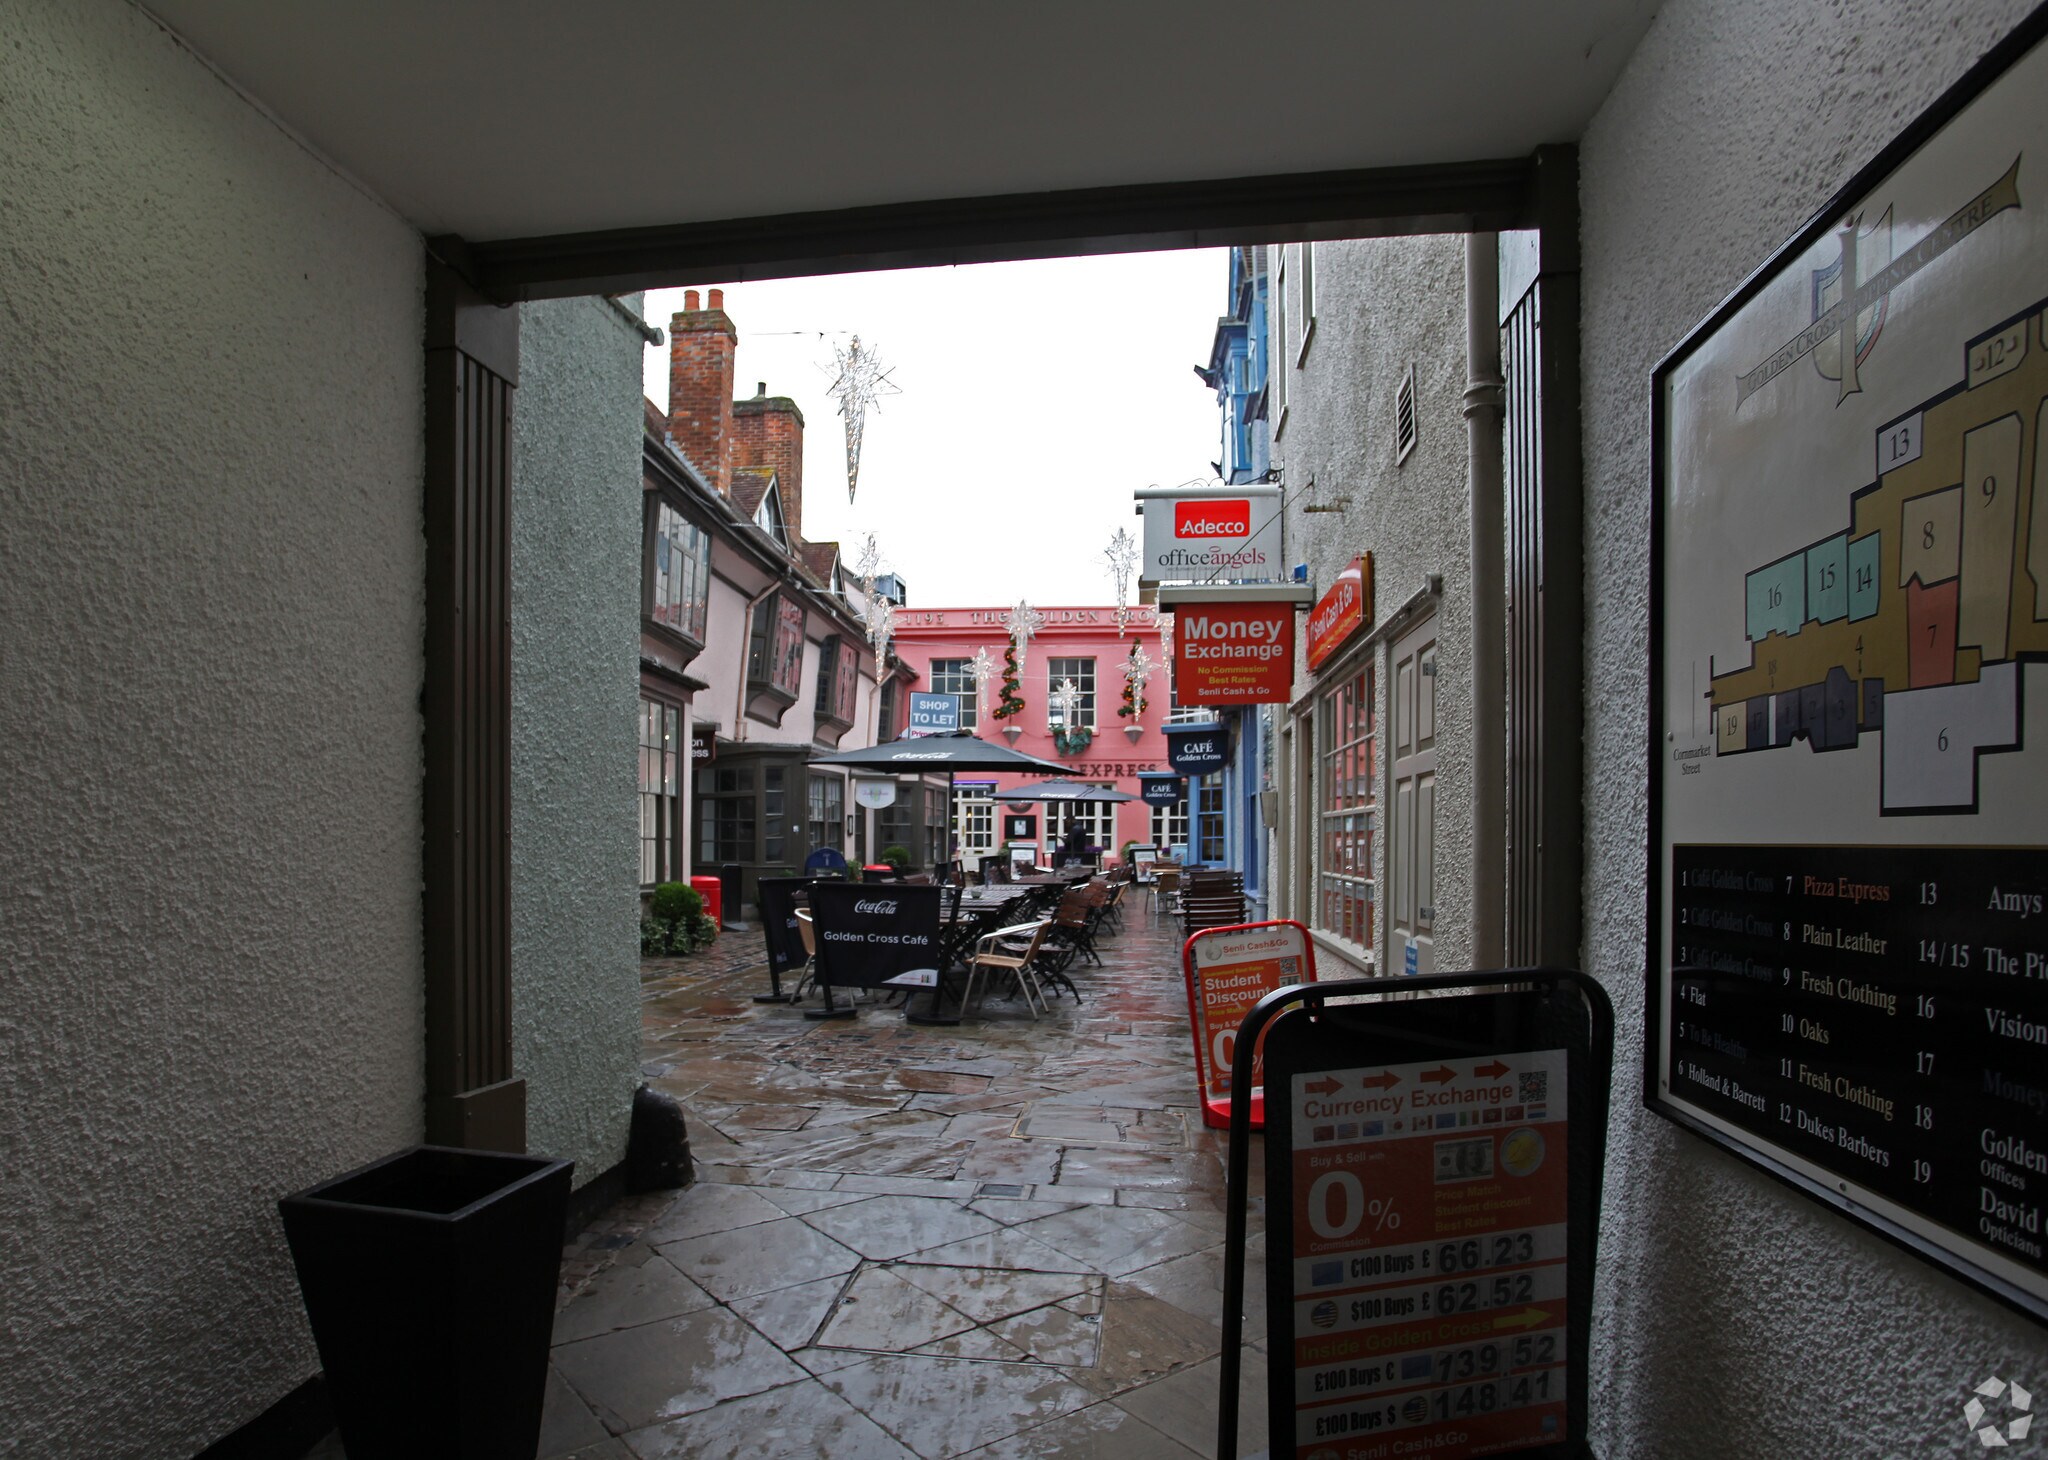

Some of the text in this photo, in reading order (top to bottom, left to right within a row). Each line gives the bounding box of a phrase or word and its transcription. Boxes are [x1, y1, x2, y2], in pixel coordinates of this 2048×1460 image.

[1986, 338, 2005, 370] 12
[1890, 428, 1910, 463] 13
[1982, 475, 1996, 508] 9
[1180, 519, 1245, 535] Adecco
[1922, 520, 1935, 550] 8
[1819, 563, 1835, 592] 15
[1855, 565, 1873, 592] 14
[1326, 598, 1339, 629] Cash
[1344, 583, 1353, 608] Go
[1768, 583, 1782, 609] 16
[1184, 617, 1283, 644] Money
[1927, 624, 1937, 649] 7
[1184, 642, 1283, 661] Exchange
[1855, 635, 1864, 656] 4
[1198, 665, 1268, 674] No Commission
[1208, 675, 1257, 684] Best Rates
[1198, 687, 1270, 696] Senli Cash & Go
[913, 713, 955, 725] TO LET
[919, 700, 949, 711] SHOP
[1726, 715, 1738, 736] 19
[1184, 740, 1213, 754] CAFÉ
[1937, 727, 1948, 752] 6
[1176, 753, 1221, 762] Golden Cross
[1673, 745, 1711, 762] Cornmarket
[1682, 763, 1701, 776] Street
[1151, 783, 1172, 793] CAFÉ
[1682, 868, 1775, 893] 1 Café Golden Cross
[1785, 875, 1890, 905] 7 Pizza Express
[1920, 882, 2042, 919] 13 Amys
[1681, 907, 1774, 937] 2 Café Golden Cross
[823, 931, 929, 946] Golden Cross Café
[1223, 944, 1245, 954] Senli
[1247, 939, 1288, 951] Cash&Go
[1783, 921, 1887, 955] 8 Plain Leather
[1680, 946, 1774, 982] 3 Café Golden Cross
[1983, 947, 2018, 976] The
[2024, 952, 2048, 980] Pi
[1204, 972, 1262, 991] Student
[1783, 967, 1896, 1016] 9 Fresh Clothing
[1206, 986, 1271, 1006] Discount
[1680, 984, 1706, 1007] 4 Flat
[1917, 995, 1935, 1019] 16
[1679, 1021, 1747, 1064] 5 To Be Healthy
[1781, 1013, 1830, 1045] 10 Oaks
[1678, 1060, 1766, 1113] 6 Holland & Barrett
[1780, 1058, 1895, 1121] 11 Fresh Clothing
[1917, 1050, 2048, 1115] 17 Money
[1304, 1083, 1513, 1120] Currency Exchange
[1779, 1102, 1890, 1168] 12 Dukes Barbers
[1915, 1104, 2048, 1174] 18 Golden
[1310, 1156, 1332, 1169] Buy
[1335, 1153, 1344, 1165] &
[1346, 1151, 1366, 1164] Sell
[1913, 1158, 2026, 1191] 19 Offices
[1434, 1183, 1502, 1202] Price Match
[1435, 1195, 1532, 1218] Student discount
[1980, 1187, 2039, 1233] David
[1435, 1215, 1497, 1233] Best Rates
[1979, 1216, 2041, 1259] Opticians
[1310, 1235, 1371, 1253] Commission
[1351, 1232, 1534, 1279] €100 Buys £ 66.23
[1351, 1274, 1534, 1323] $100 Buys £ 62.52
[1302, 1321, 1492, 1361] Inside Golden Cross
[1314, 1335, 1556, 1393] £100 Buys € 139.52
[1315, 1371, 1550, 1438] £100 Buys $ 148.41
[1347, 1432, 1468, 1460] Senli Cash&Go
